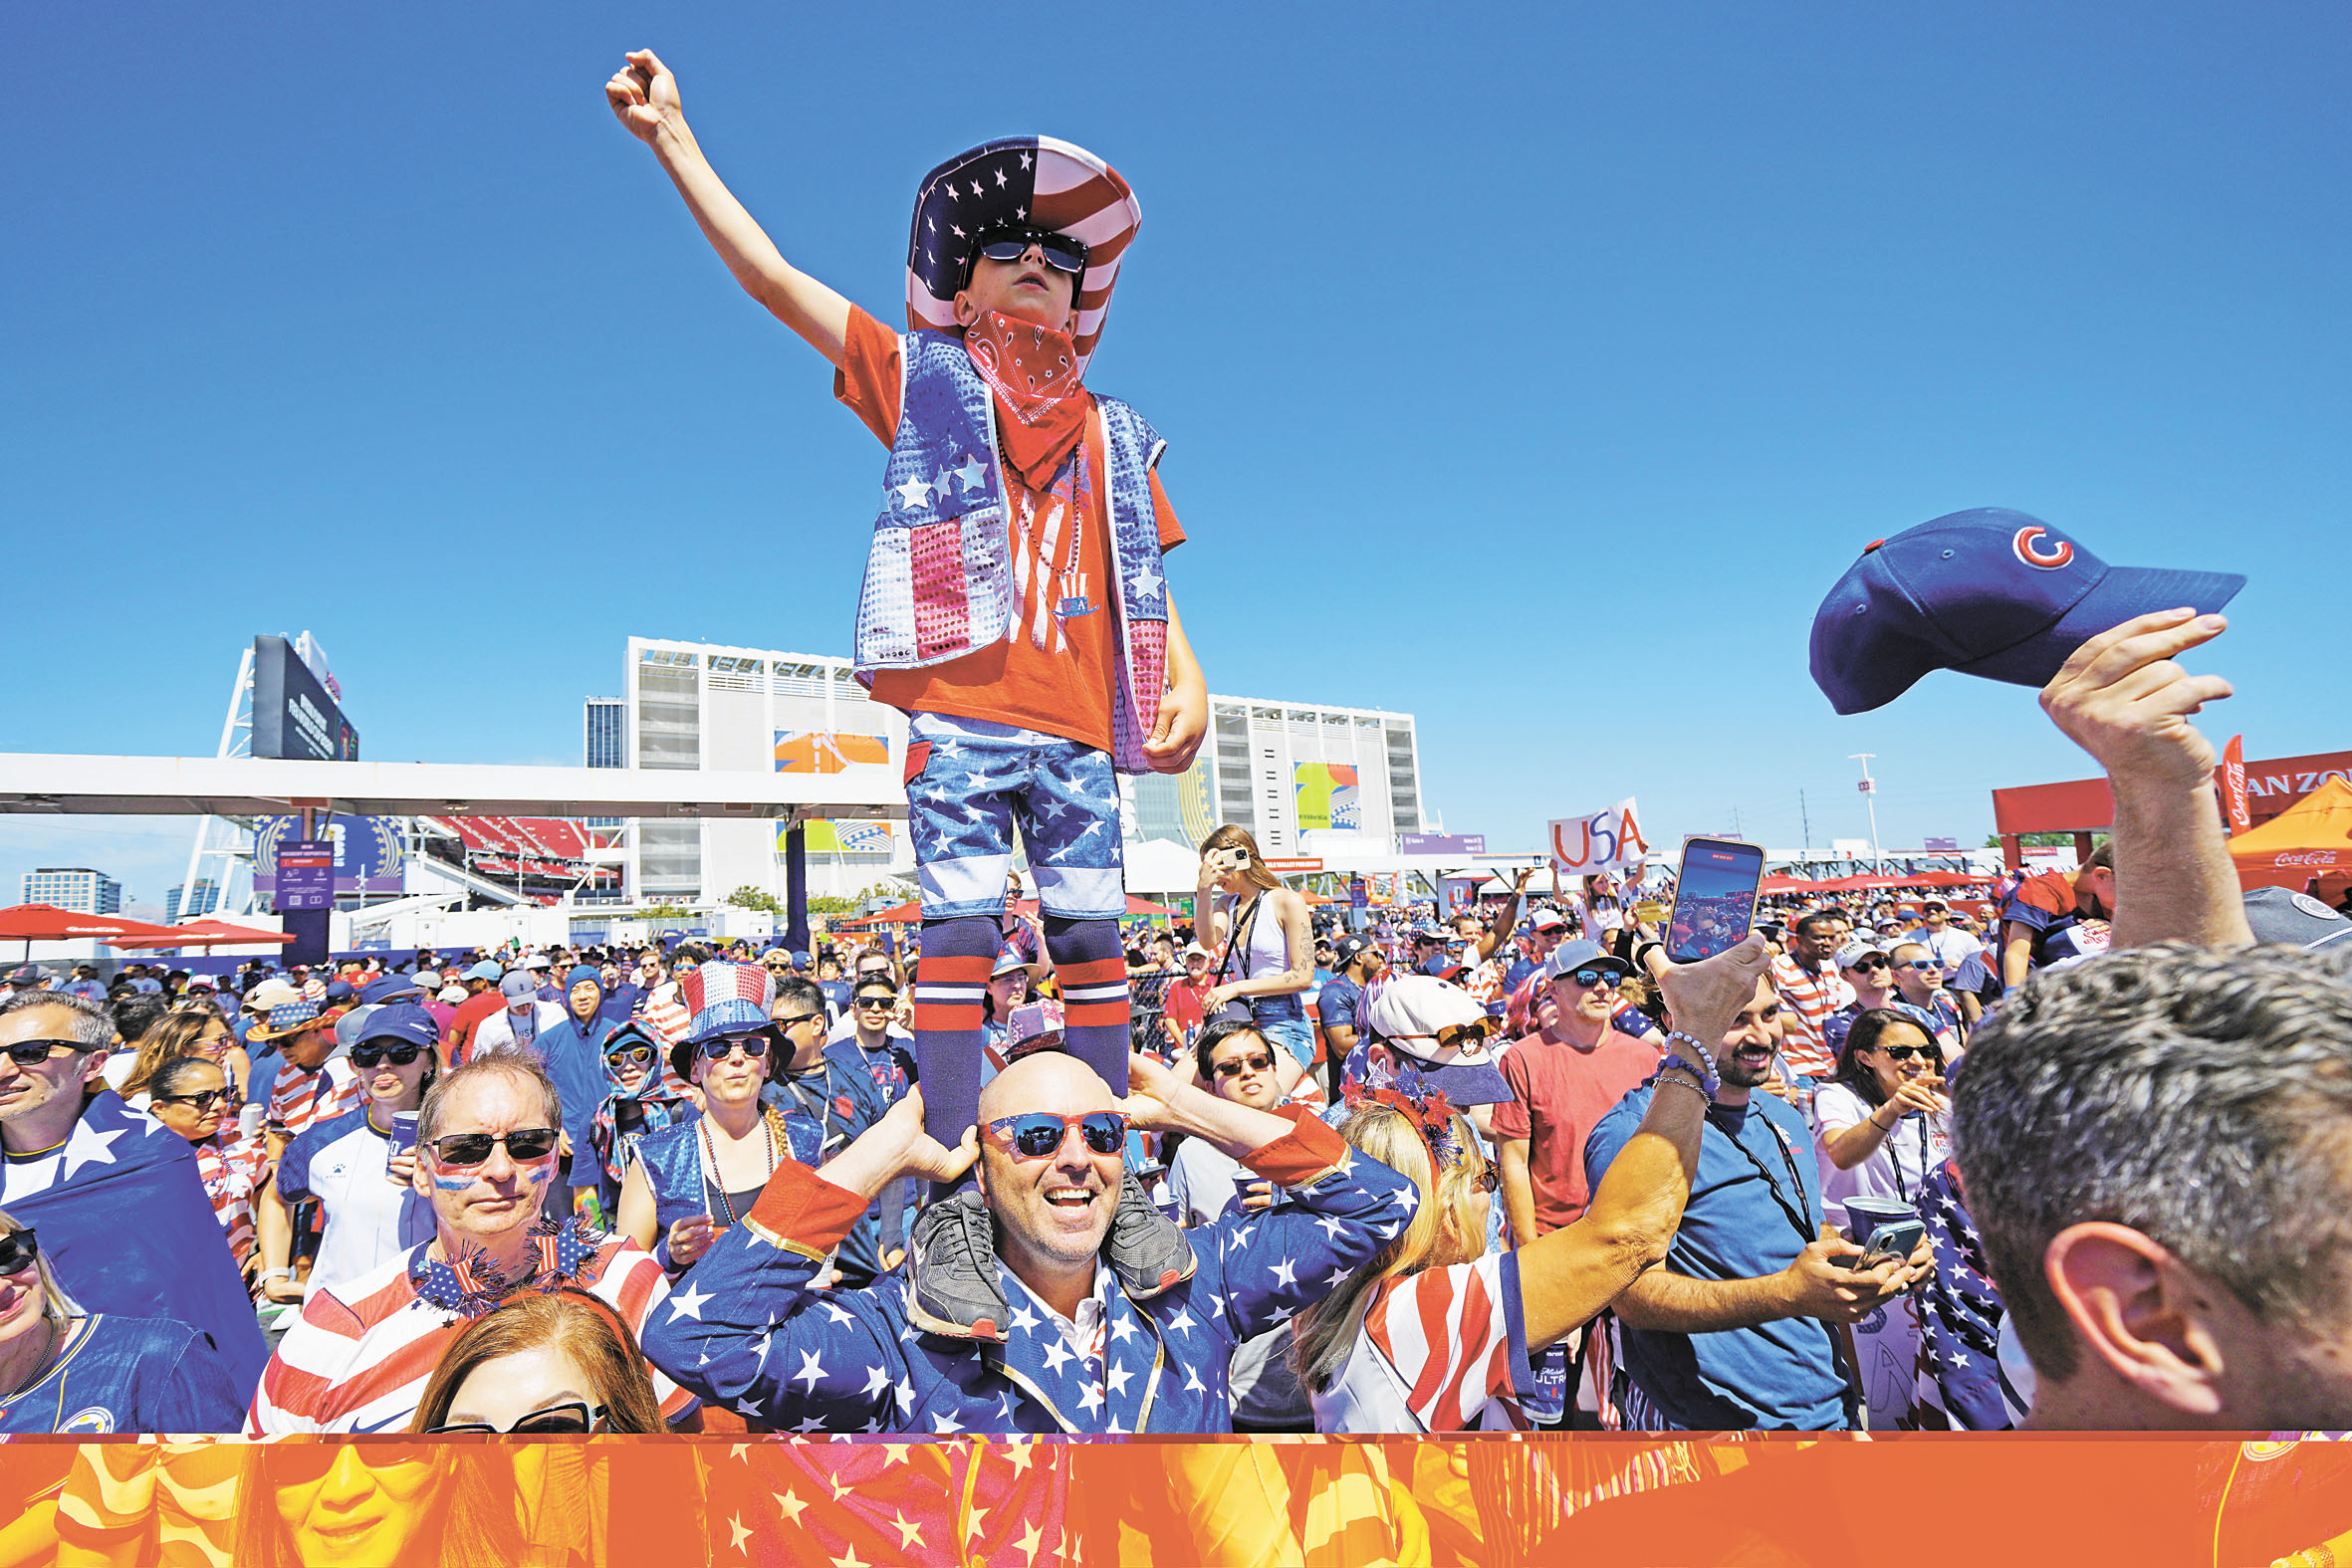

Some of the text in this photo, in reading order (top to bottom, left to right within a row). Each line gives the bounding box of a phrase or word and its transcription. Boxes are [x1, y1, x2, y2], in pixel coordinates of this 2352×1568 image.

[2012, 526, 2074, 571] C
[2246, 769, 2352, 797] AN ZO
[1554, 807, 1647, 867] USA
[2275, 850, 2337, 867] Coca-Cola
[872, 1066, 903, 1085] SA
